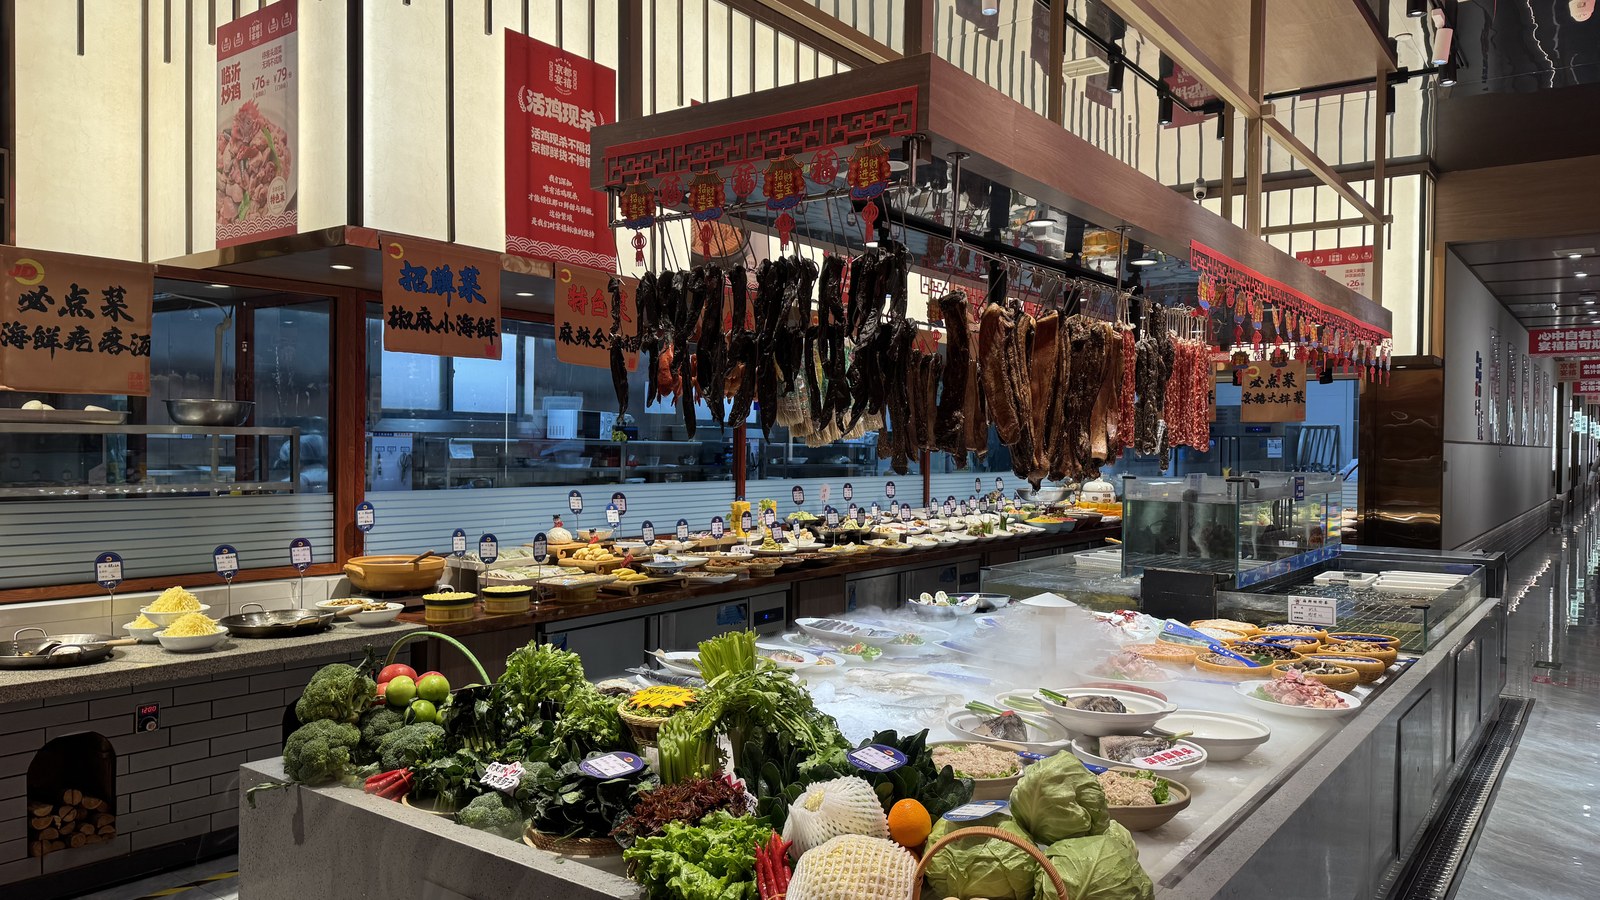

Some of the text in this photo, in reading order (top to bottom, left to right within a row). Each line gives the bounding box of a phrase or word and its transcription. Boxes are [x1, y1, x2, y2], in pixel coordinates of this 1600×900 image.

[221, 61, 241, 86] 临沂
[554, 63, 573, 78] 京都
[221, 82, 241, 106] 炒鸡
[526, 88, 597, 133] 活鸡现杀
[399, 260, 487, 307] 招牌菜
[17, 283, 135, 322] 必点菜
[559, 321, 641, 354] 麻辣全福
[1250, 371, 1297, 389] 必点菜
